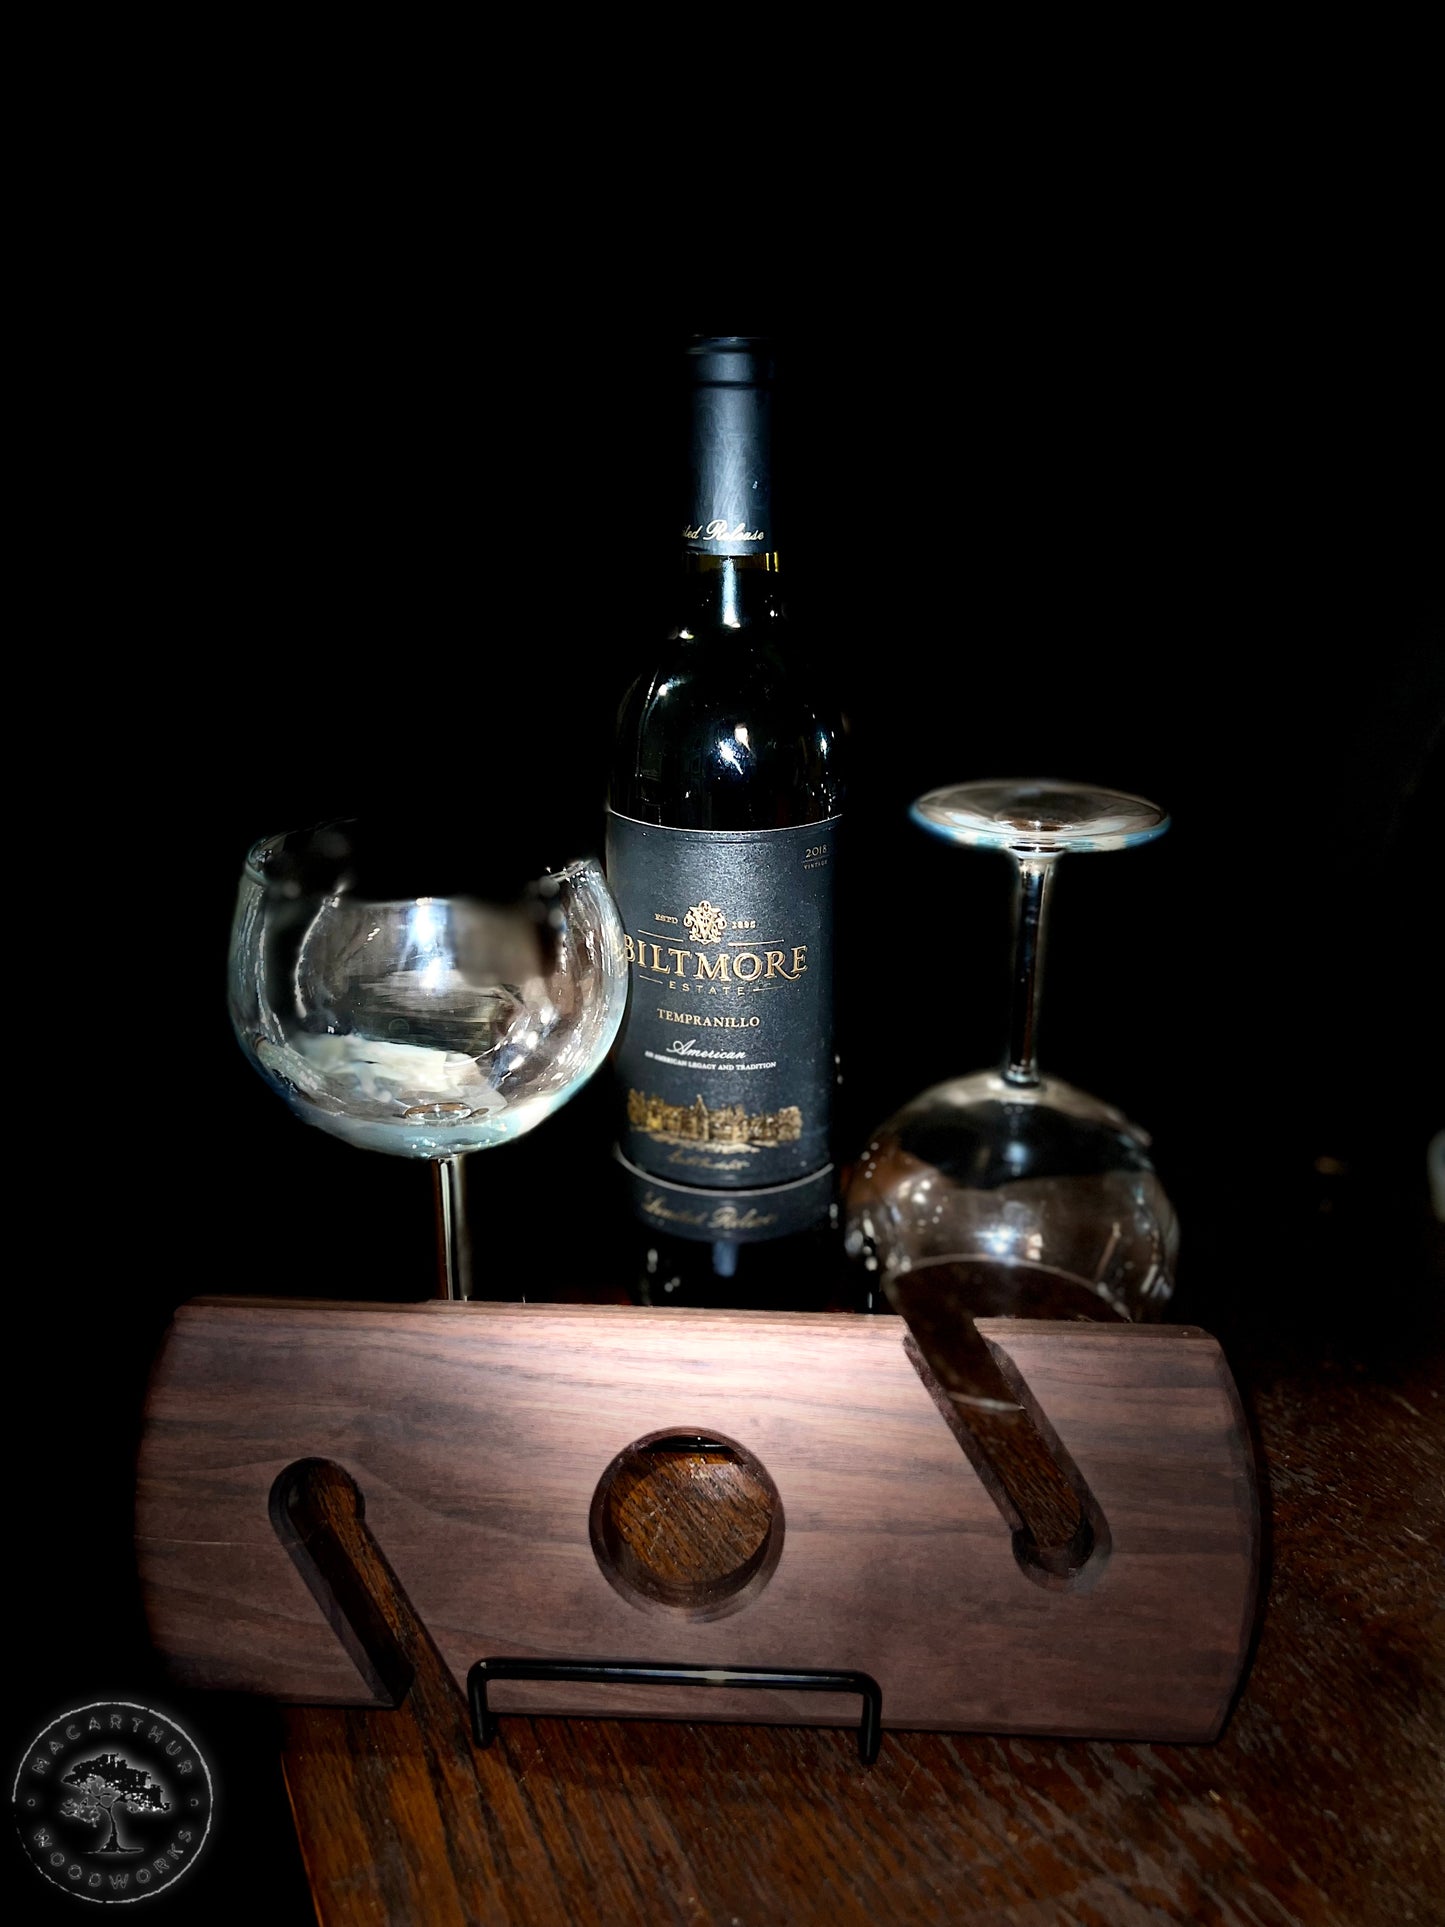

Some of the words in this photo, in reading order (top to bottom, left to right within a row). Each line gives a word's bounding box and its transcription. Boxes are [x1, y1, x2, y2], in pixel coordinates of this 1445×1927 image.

[703, 519, 765, 541] Release
[805, 843, 828, 858] 2018
[623, 933, 809, 982] BILTMORE
[668, 981, 746, 996] ESTATE
[656, 1008, 761, 1029] TEMPRANILLO
[666, 1039, 747, 1059] American
[717, 1063, 735, 1071] AND
[735, 1061, 777, 1071] TRADITION
